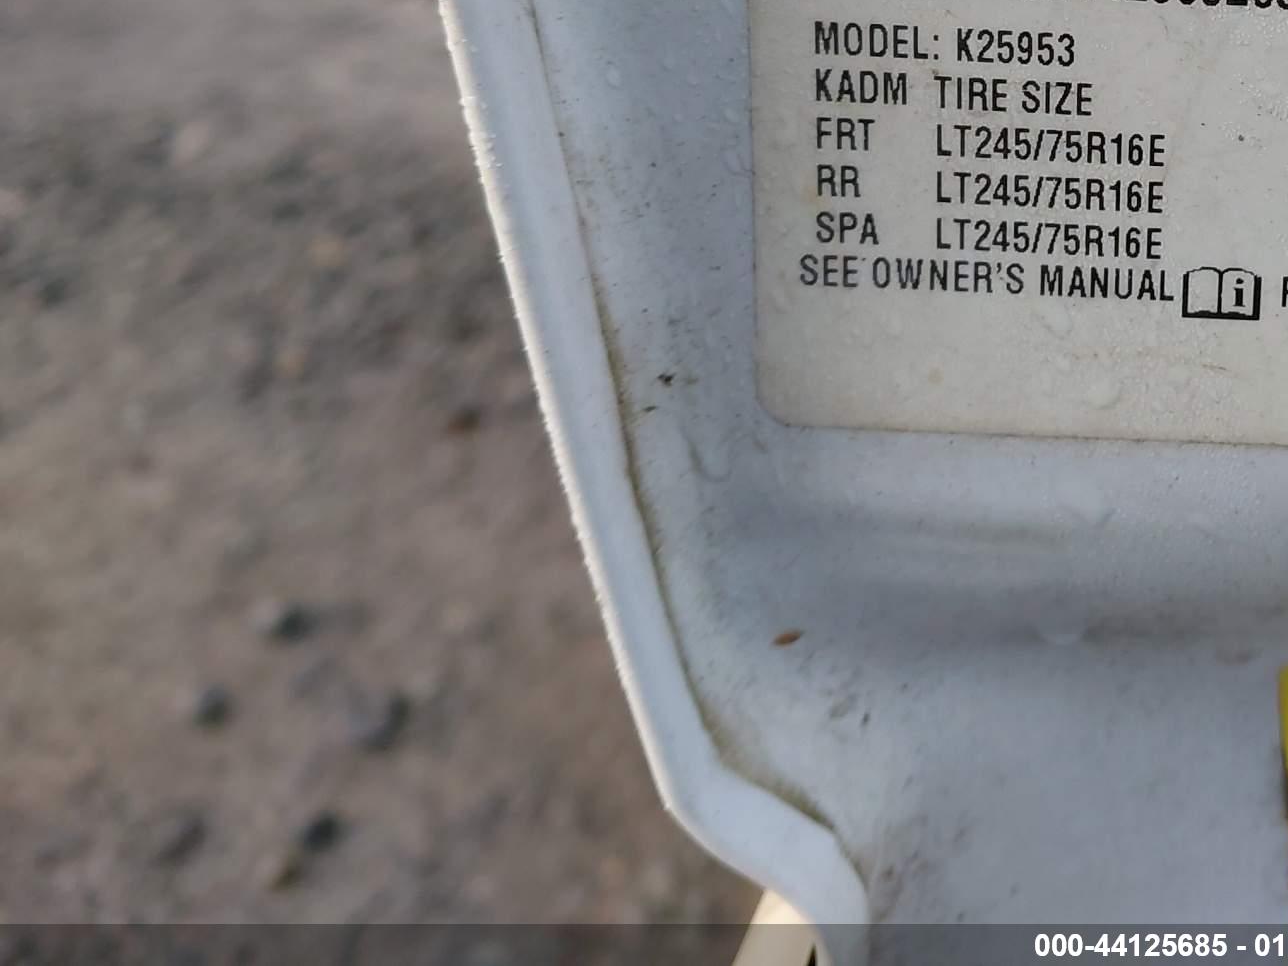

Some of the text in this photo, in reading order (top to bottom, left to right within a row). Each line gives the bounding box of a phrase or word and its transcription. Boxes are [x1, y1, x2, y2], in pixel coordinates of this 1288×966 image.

[814, 20, 1075, 68] MODEL: K25953
[815, 68, 1093, 117] KADM TIRE SIZE
[816, 116, 876, 151] FRT
[936, 123, 1166, 168] LT245/75R16E
[816, 163, 861, 198] RR
[936, 170, 1164, 214] LT245/75R16E
[816, 211, 880, 246] SPA
[936, 217, 1163, 260] LT245/75R16E
[799, 253, 859, 288] SEE
[872, 256, 1025, 295] OWNER'S
[1039, 264, 1175, 302] MANUAL
